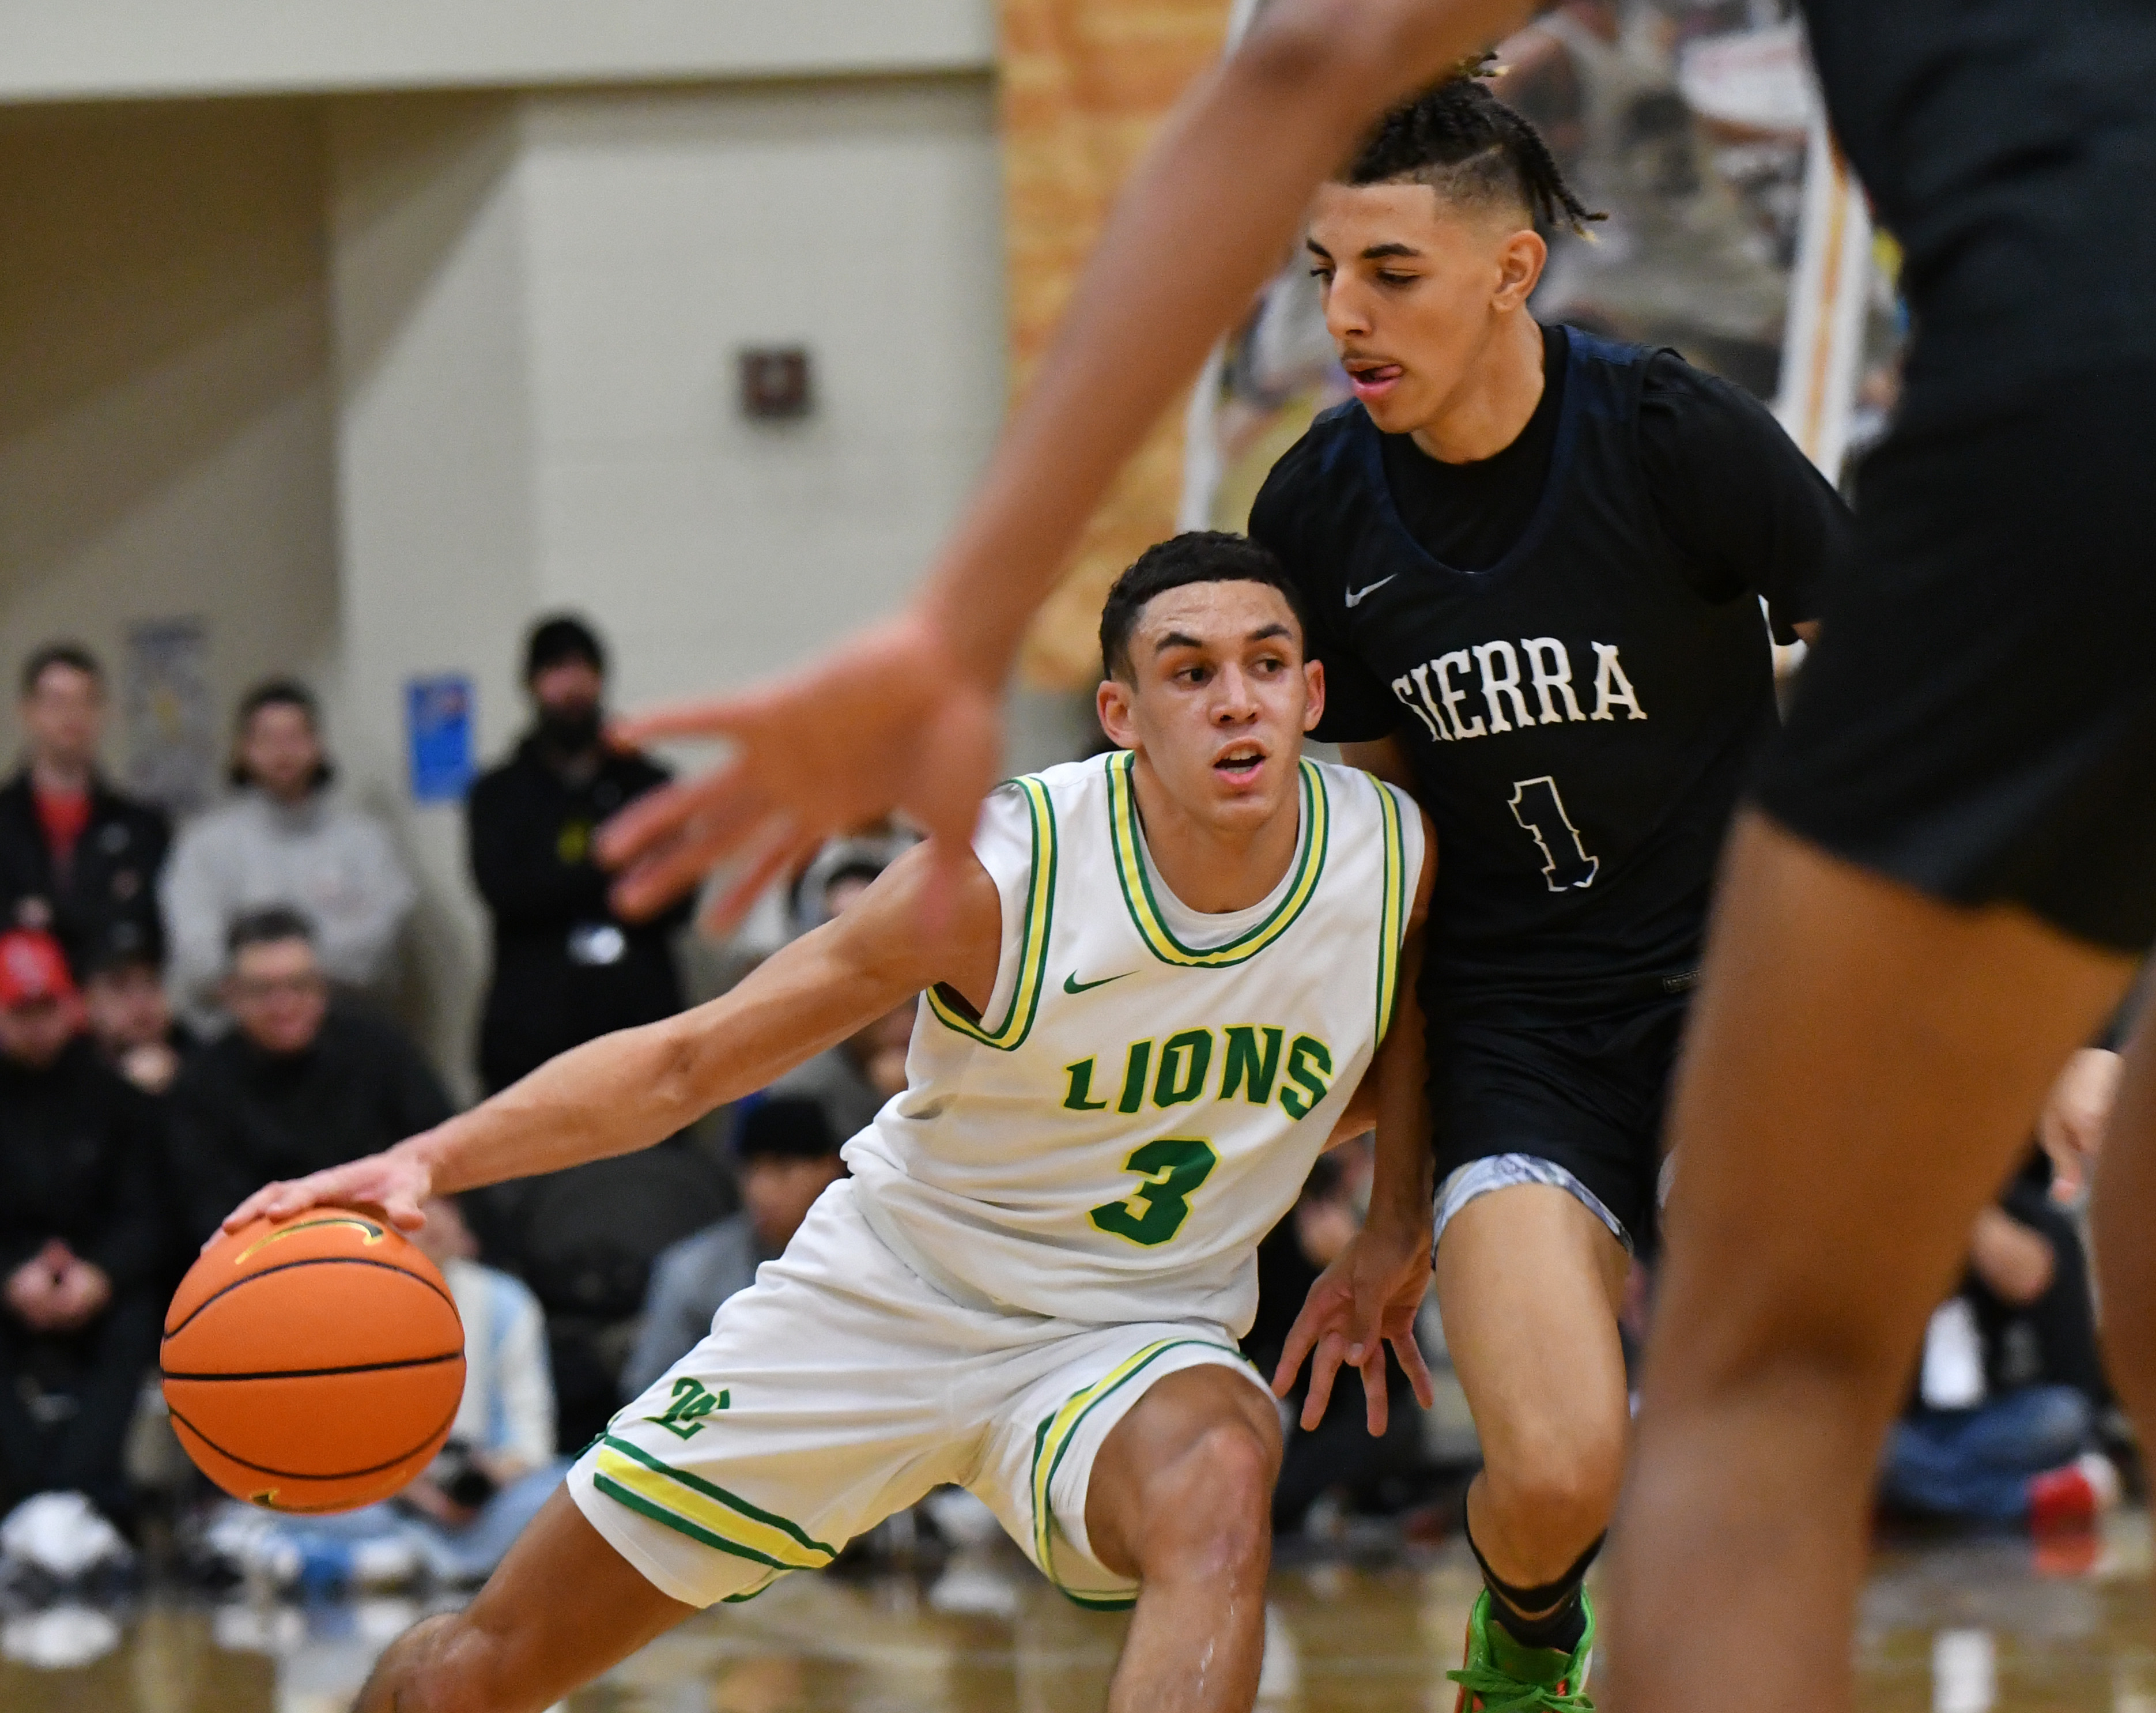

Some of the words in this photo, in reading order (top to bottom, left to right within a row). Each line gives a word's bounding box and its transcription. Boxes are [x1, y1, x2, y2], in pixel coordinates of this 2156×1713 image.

[1391, 637, 1647, 742] SIERRA
[1508, 775, 1599, 892] 1
[1062, 1023, 1334, 1122] LIONS
[1085, 1136, 1222, 1250] 3
